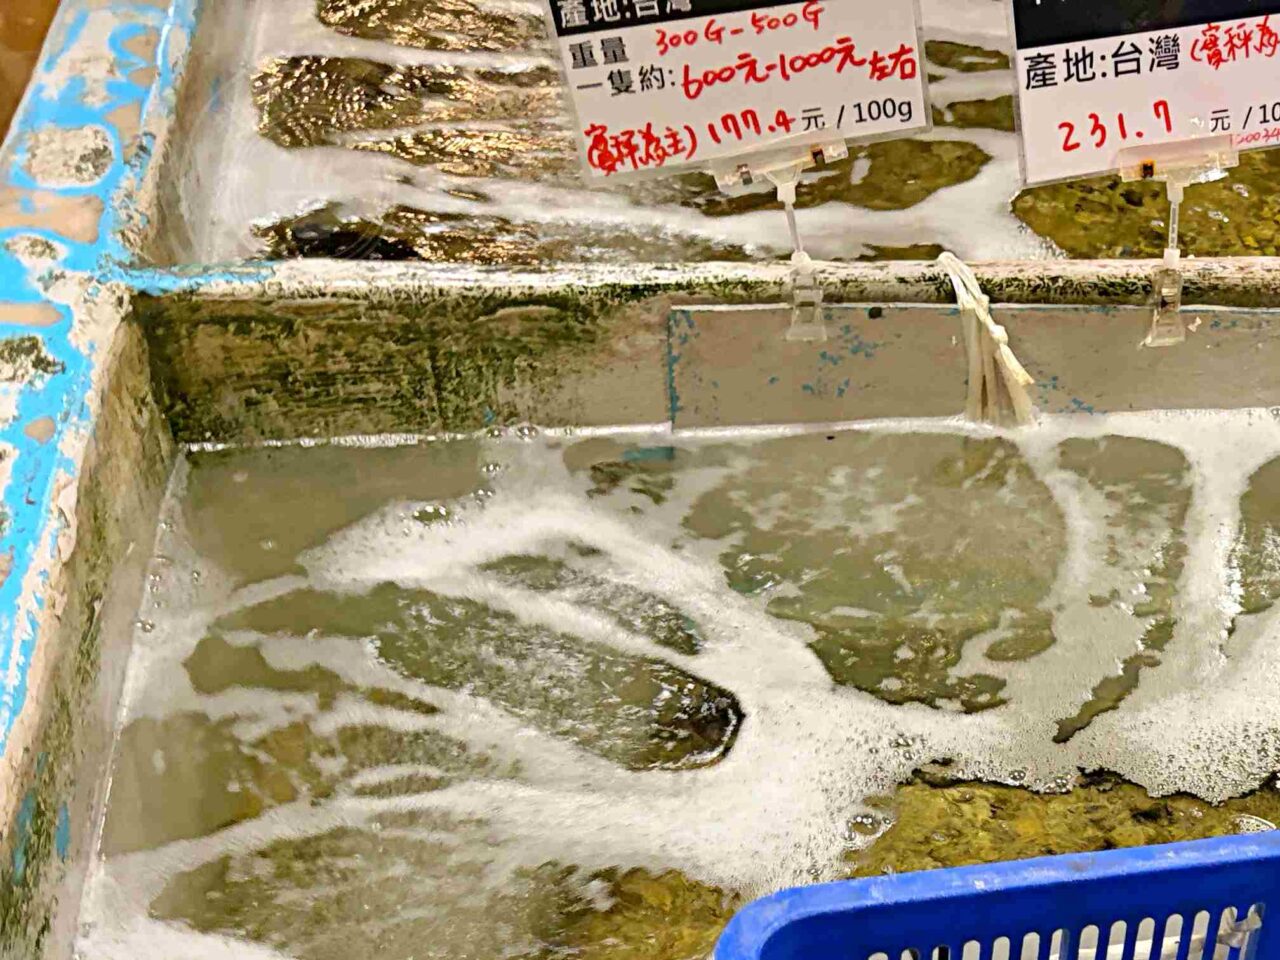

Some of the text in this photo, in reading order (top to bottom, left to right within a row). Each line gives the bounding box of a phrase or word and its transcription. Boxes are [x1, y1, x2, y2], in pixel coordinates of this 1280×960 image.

[569, 36, 628, 69] 重量
[1024, 33, 1181, 91] 產地:台灣
[576, 65, 675, 98] 一隻約:
[707, 108, 796, 144] 177.4
[1058, 99, 1172, 152] 231.7
